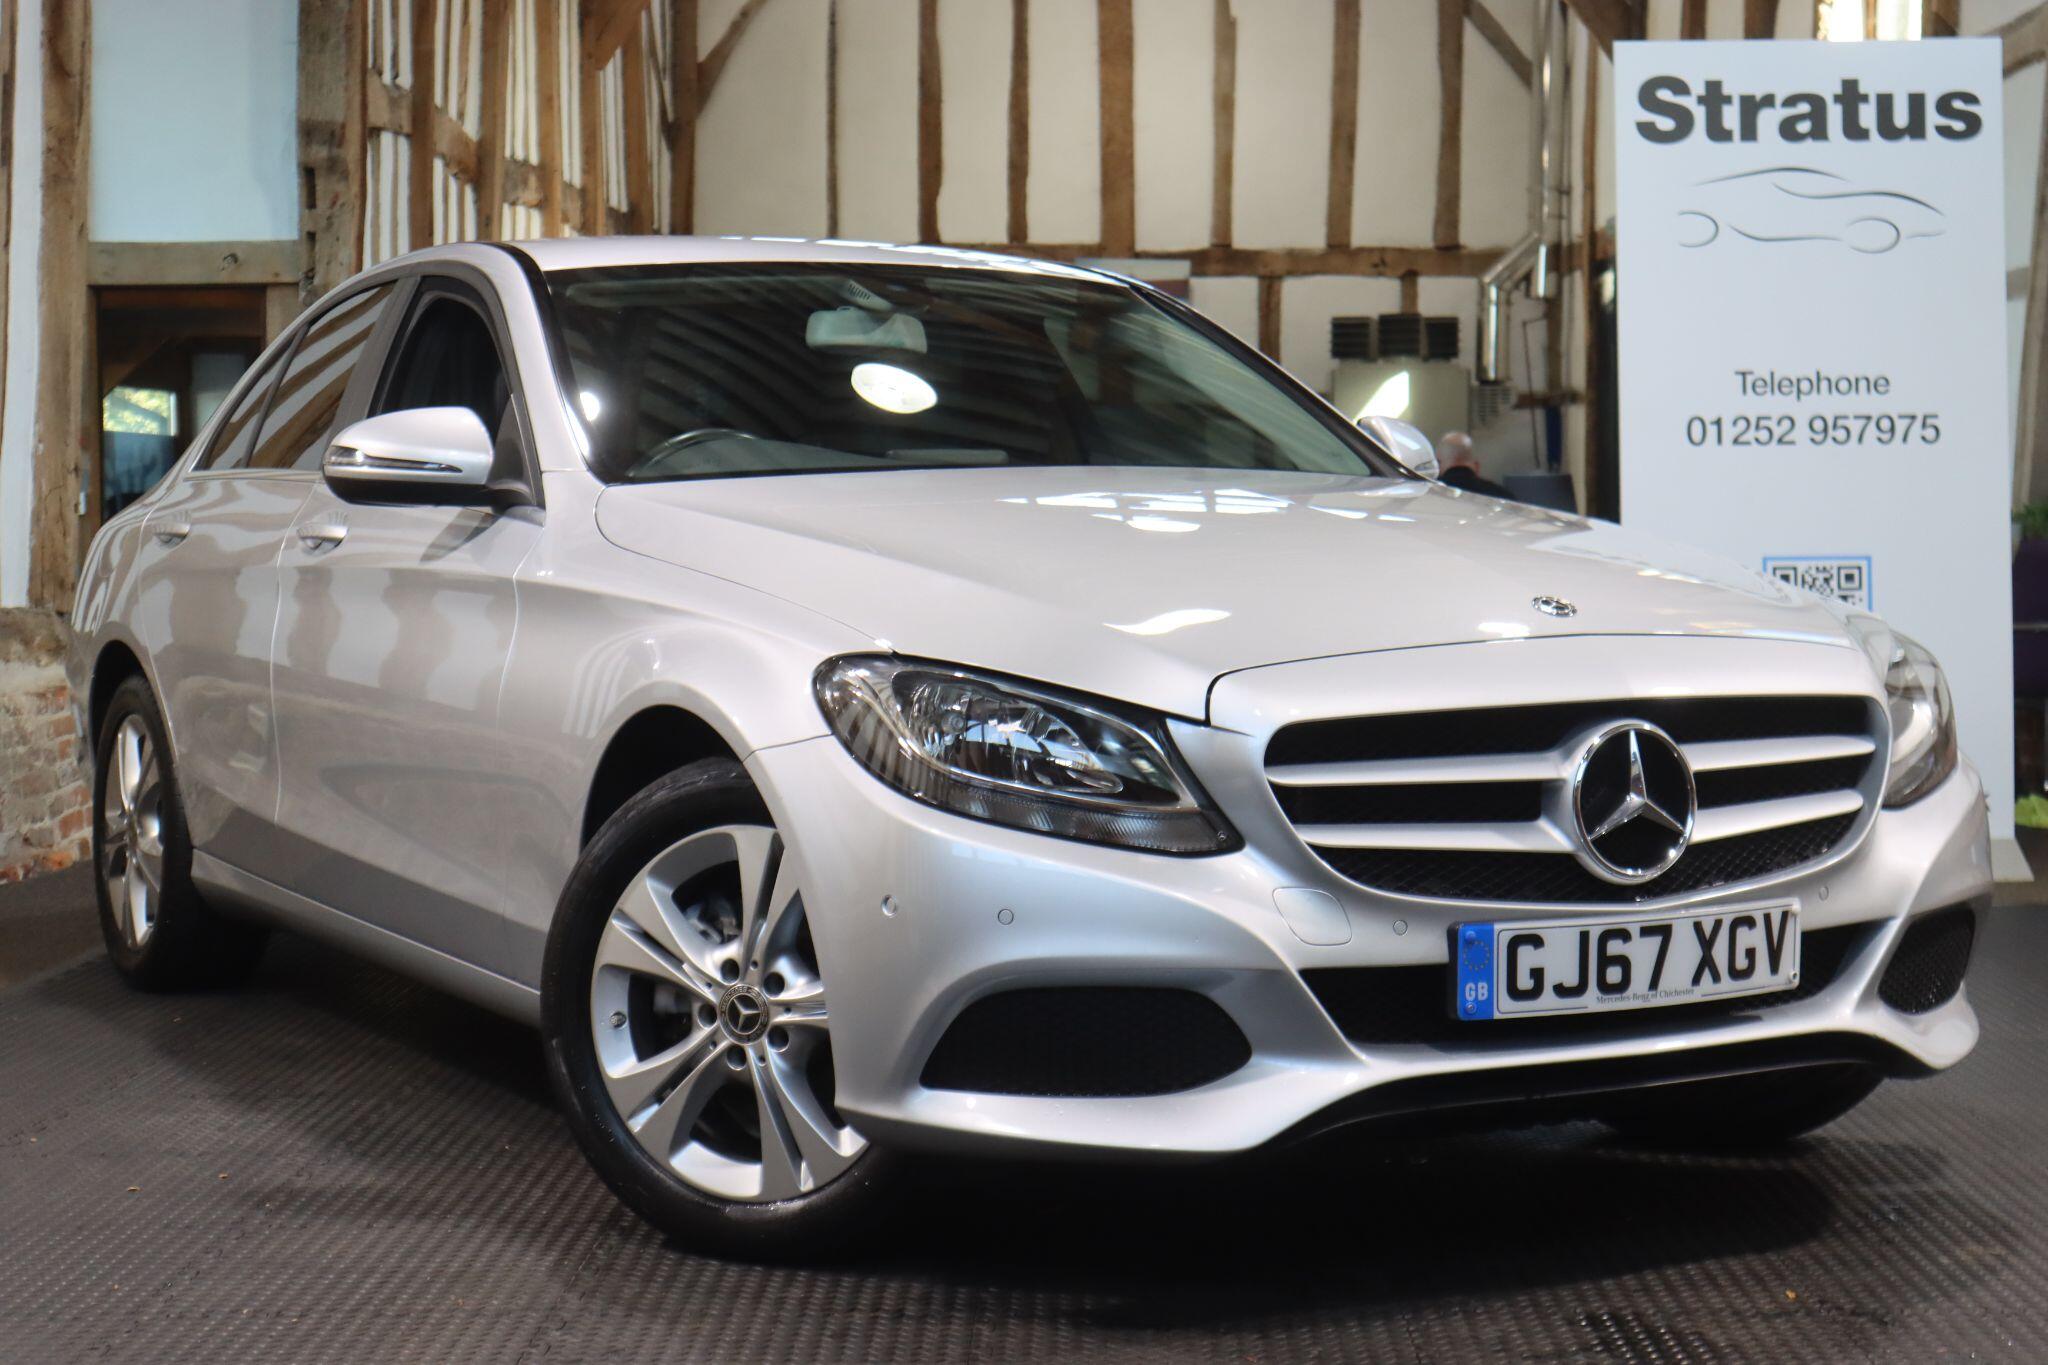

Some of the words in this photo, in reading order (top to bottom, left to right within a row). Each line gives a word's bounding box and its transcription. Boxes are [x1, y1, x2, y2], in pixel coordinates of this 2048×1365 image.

[1635, 76, 1983, 144] Stratus
[1735, 370, 1891, 401] Telephone
[1686, 415, 1797, 447] 01252
[1808, 413, 1941, 446] 957975
[1506, 924, 1674, 1002] GJ67
[1691, 910, 1790, 987] XGV
[1464, 982, 1489, 1001] GB
[1659, 987, 1694, 999] Chichester
